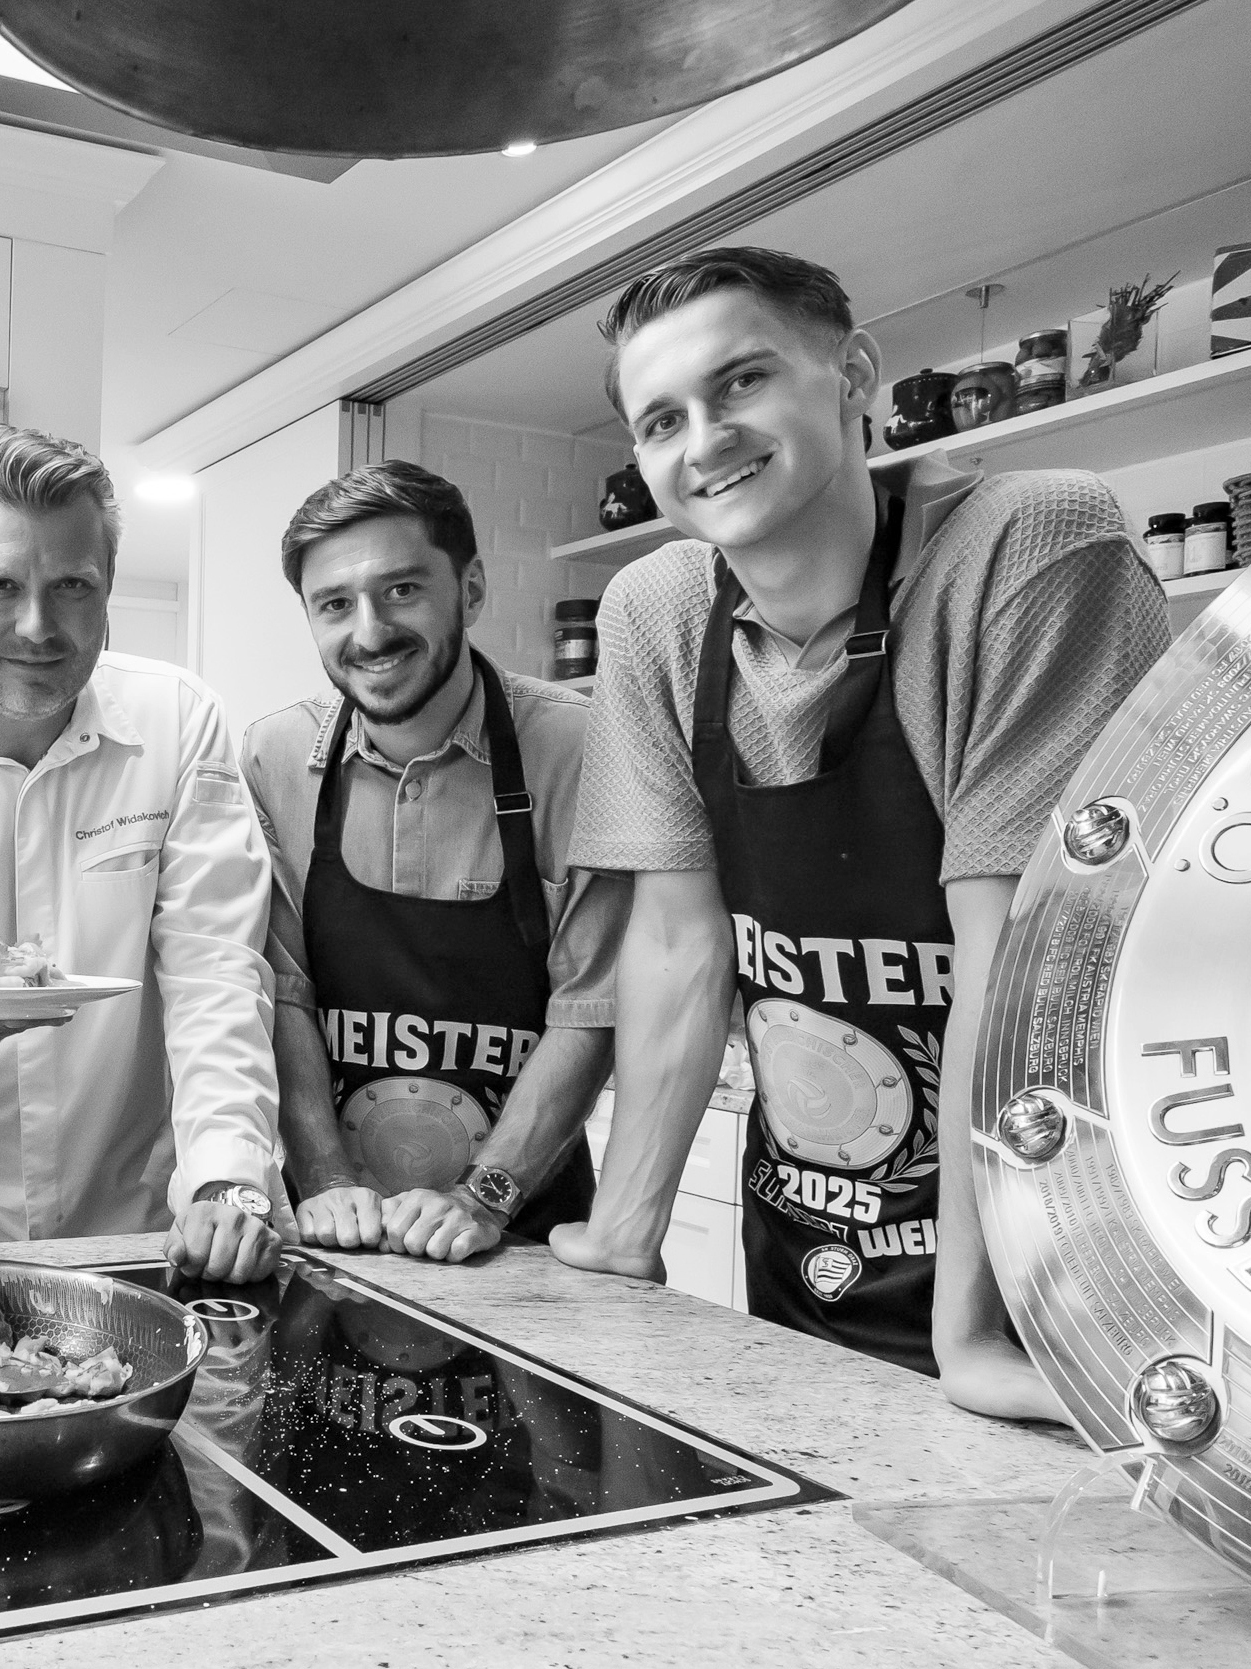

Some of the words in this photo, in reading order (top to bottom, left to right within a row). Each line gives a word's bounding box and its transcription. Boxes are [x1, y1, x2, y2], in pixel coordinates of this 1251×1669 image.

[1153, 736, 1180, 768] WIEN
[75, 820, 115, 840] Christof
[116, 809, 170, 827] Widakovich
[731, 913, 956, 1006] EISTER
[1040, 963, 1053, 986] RED
[1046, 946, 1058, 961] FC
[1054, 961, 1068, 984] RED
[1099, 965, 1111, 981] SK
[1034, 987, 1048, 1016] BULL
[1049, 986, 1063, 1014] BULL
[1063, 981, 1077, 1015] MILCH
[1078, 964, 1096, 1013] AUSTRIA
[1093, 982, 1108, 1018] RAPID
[318, 1007, 541, 1077] MEISTER
[1028, 1016, 1043, 1073] SALZBURG
[1043, 1016, 1057, 1074] SALZBURG
[1057, 1018, 1071, 1083] INNSBRUCK
[1073, 1013, 1087, 1067] MEMPHIS
[1089, 1018, 1102, 1050] WIEN
[1140, 1036, 1251, 1250] FUSS
[776, 1164, 882, 1224] 2025
[1085, 1155, 1110, 1210] 1991/1992
[1105, 1163, 1134, 1220] 1982/1983
[1039, 1180, 1064, 1237] 2018/2019
[857, 1218, 936, 1259] WEI
